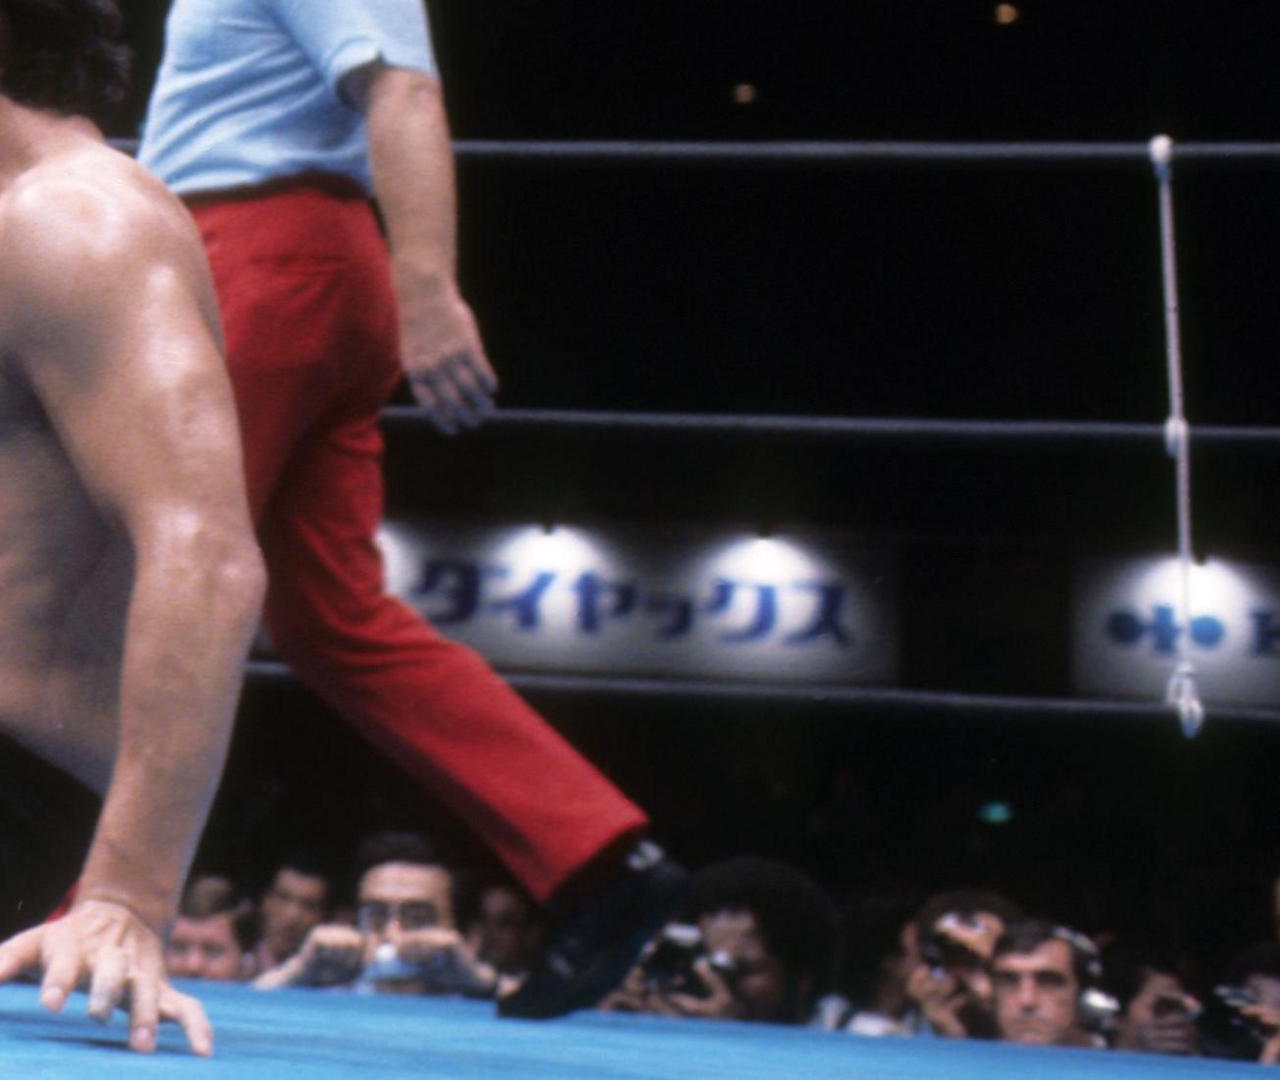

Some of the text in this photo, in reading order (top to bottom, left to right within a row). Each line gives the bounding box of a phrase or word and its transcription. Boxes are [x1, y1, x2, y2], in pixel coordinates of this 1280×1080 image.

[416, 558, 854, 648] ダイヤックス
